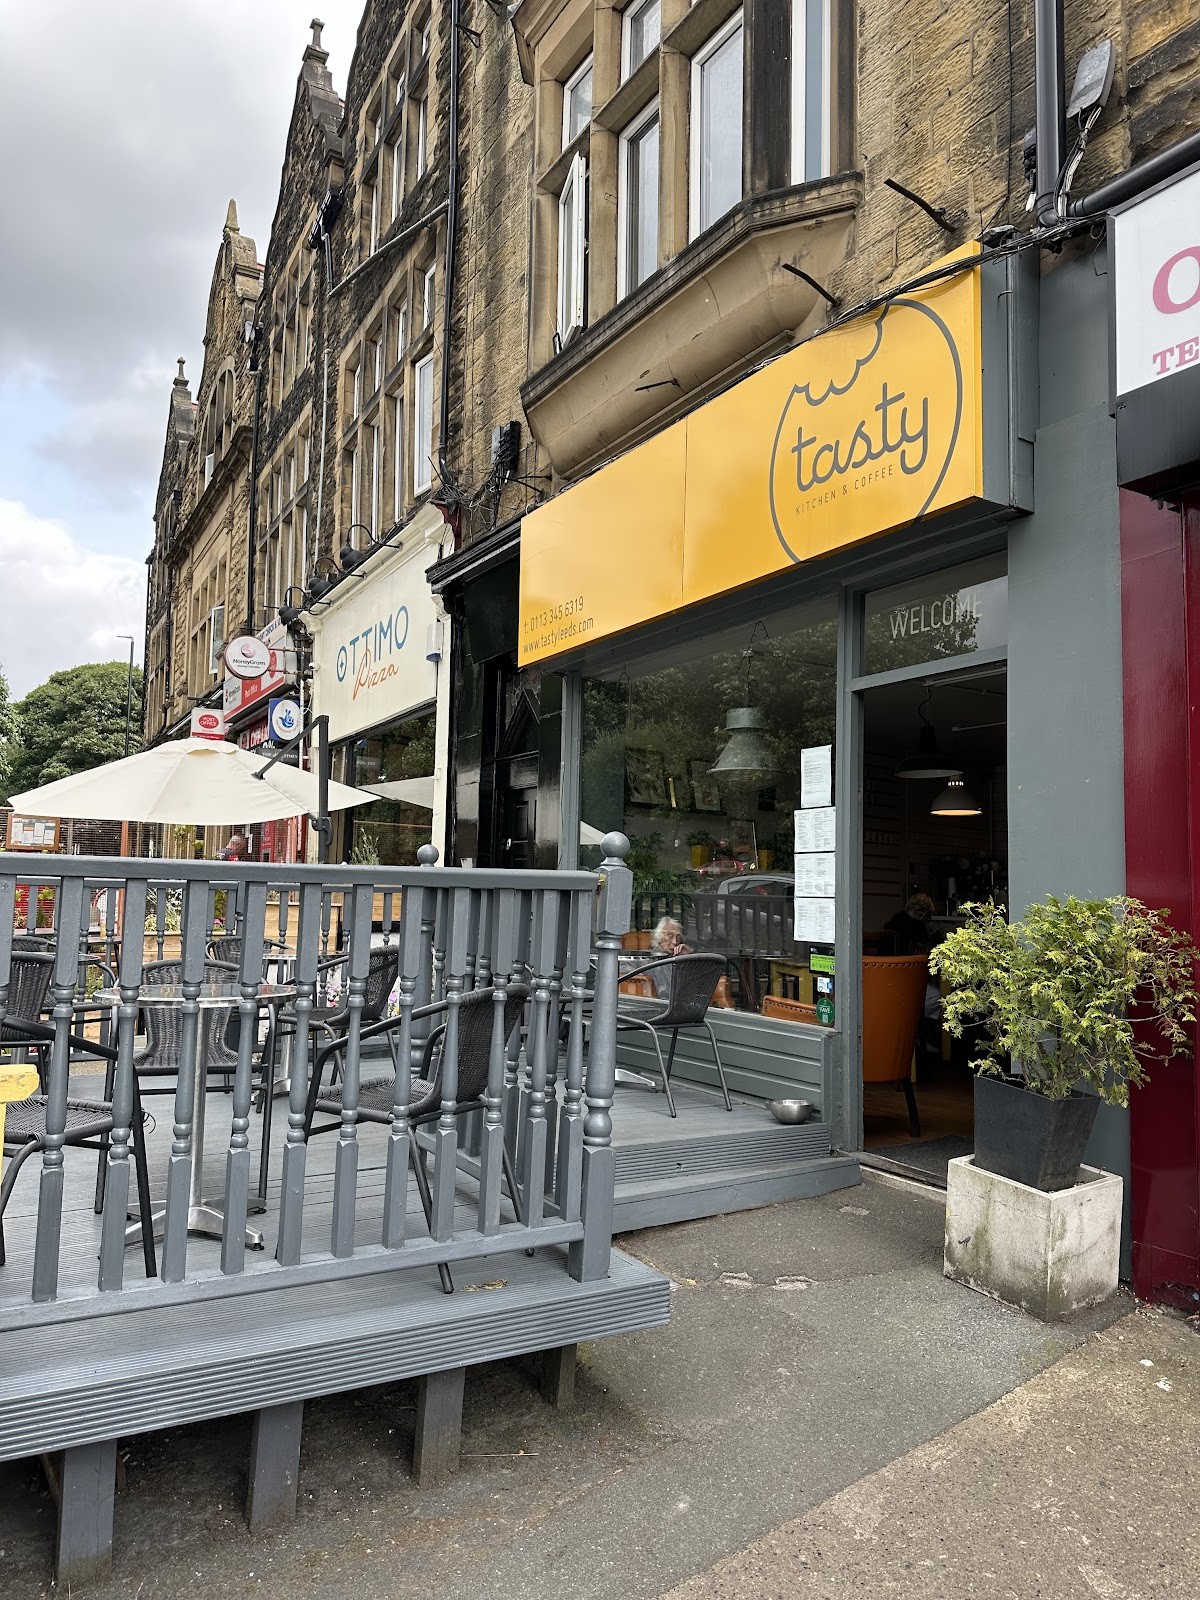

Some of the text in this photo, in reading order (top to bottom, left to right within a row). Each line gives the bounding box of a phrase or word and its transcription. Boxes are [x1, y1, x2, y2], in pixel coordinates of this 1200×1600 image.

[791, 381, 928, 492] tasty
[795, 464, 894, 516] KITCHEN & COFFEE
[524, 617, 594, 654] www.tastyleeds.com
[530, 611, 548, 632] 0113
[550, 605, 563, 624] 345
[565, 596, 584, 616] 6319
[889, 589, 984, 640] WELCOME
[232, 658, 266, 667] MoneyGram
[337, 606, 408, 682] OTTIMO
[352, 648, 400, 702] Pizza
